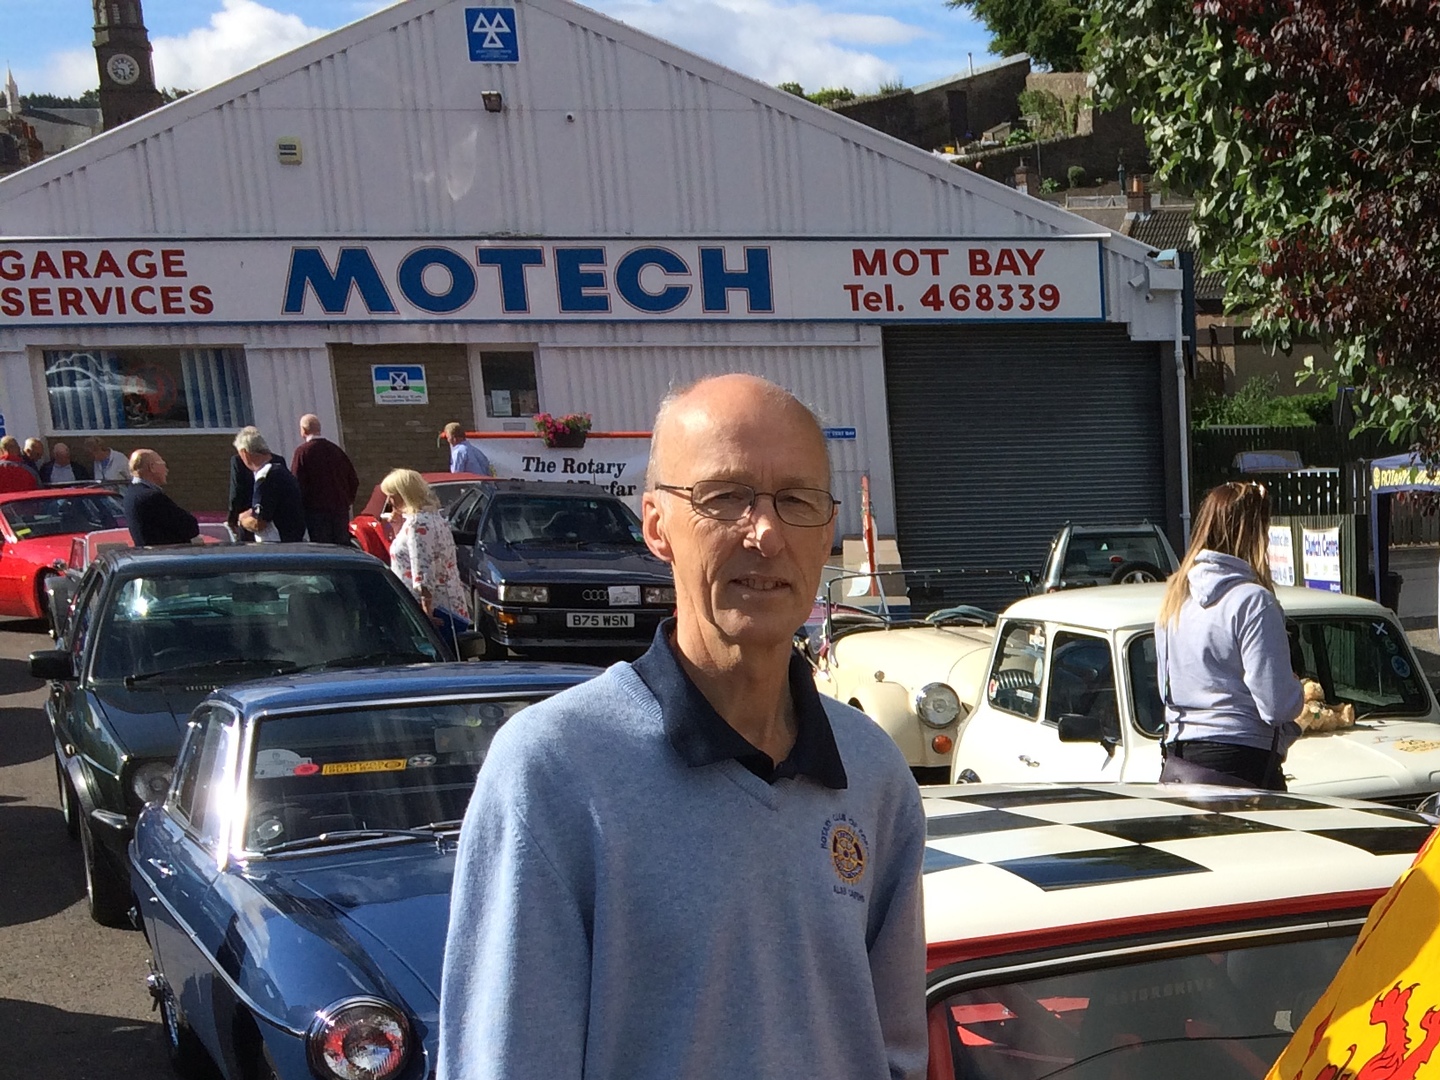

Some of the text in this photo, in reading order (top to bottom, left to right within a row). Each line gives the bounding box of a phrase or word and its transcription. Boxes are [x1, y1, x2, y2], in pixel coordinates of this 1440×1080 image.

[0, 249, 188, 281] GARAGE
[852, 248, 1046, 276] MOT BAY
[281, 245, 775, 315] MOTECH
[0, 286, 214, 316] SERVICES
[843, 283, 1060, 311] Tel. 468339
[522, 456, 626, 478] The Rotary
[572, 615, 628, 627] B75 WSN
